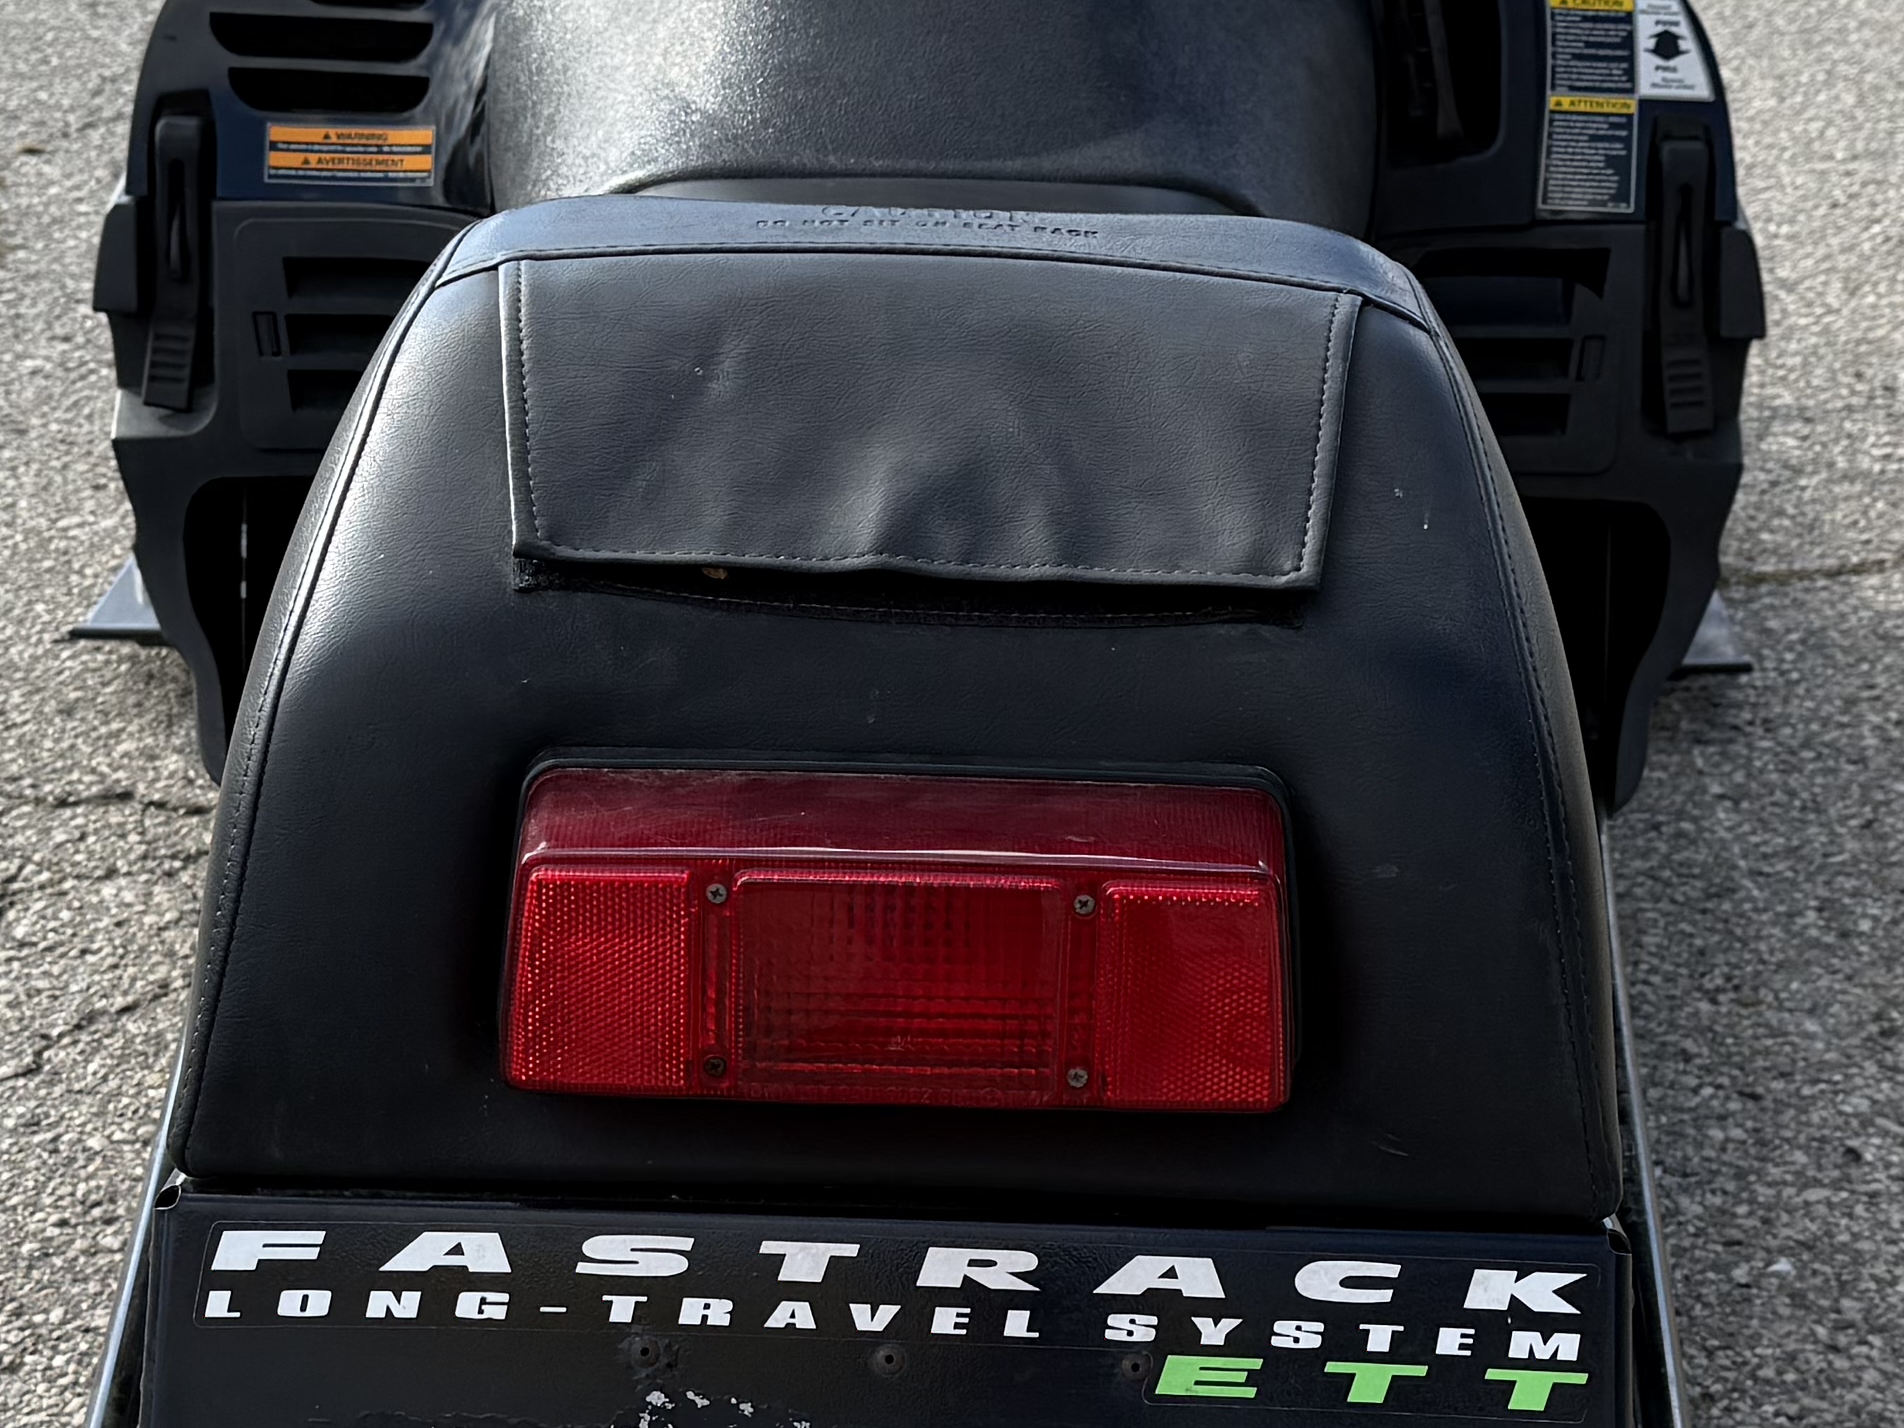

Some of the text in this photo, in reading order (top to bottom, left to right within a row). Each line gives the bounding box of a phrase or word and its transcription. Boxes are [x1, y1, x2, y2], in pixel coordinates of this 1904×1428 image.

[210, 1230, 1588, 1315] FASTRACK
[204, 1289, 1582, 1361] LONG-TRAVEL SYSTEM
[1155, 1354, 1588, 1412] ETT
